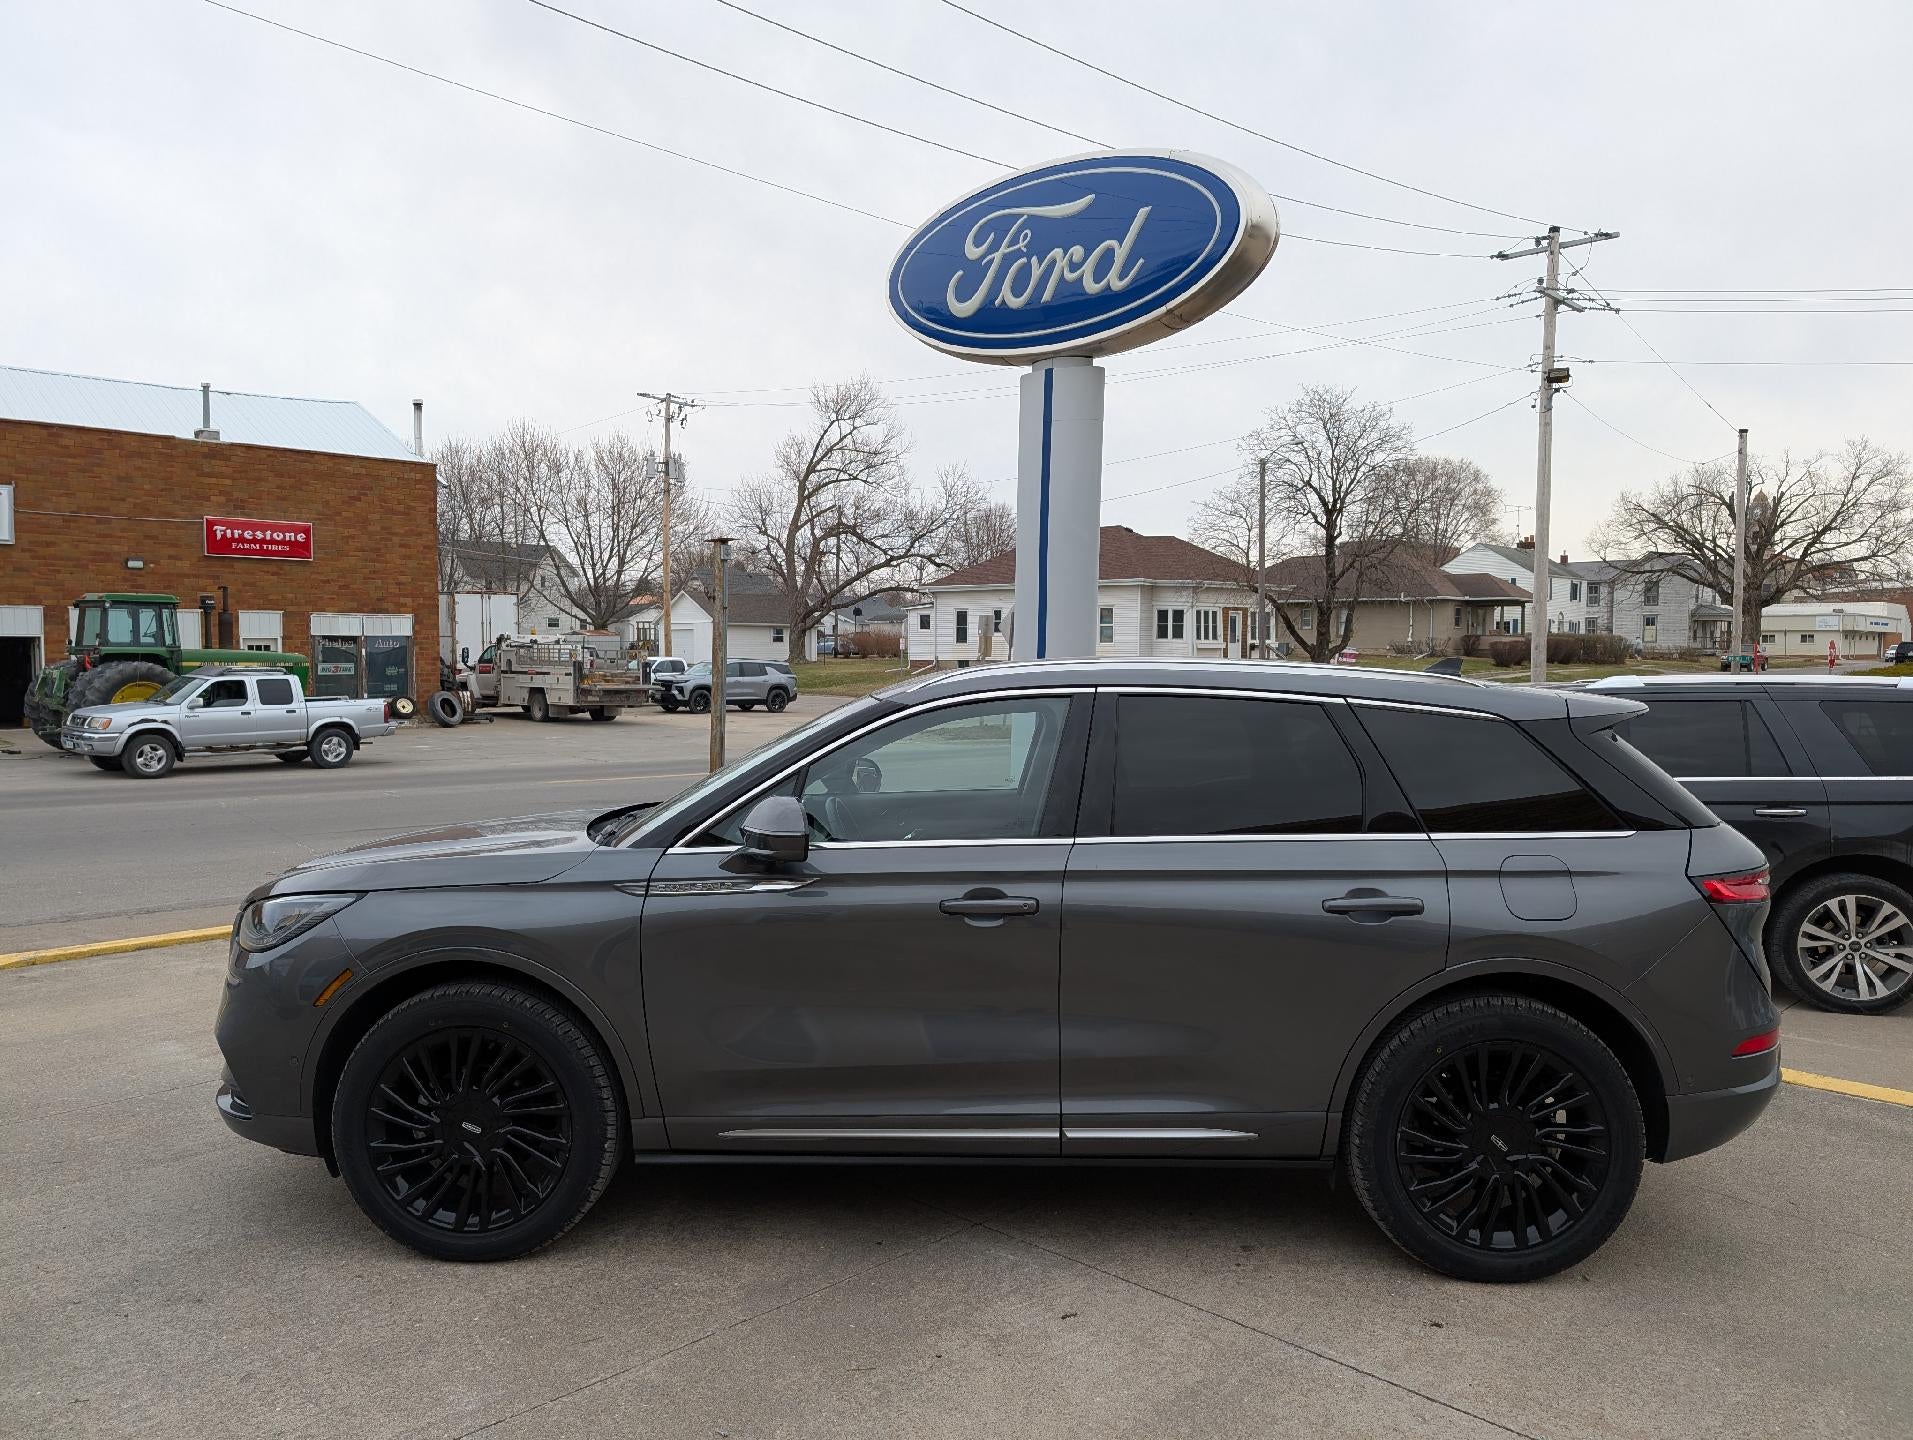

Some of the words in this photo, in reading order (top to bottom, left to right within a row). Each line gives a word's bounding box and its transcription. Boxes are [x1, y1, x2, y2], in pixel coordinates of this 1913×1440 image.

[946, 193, 1152, 319] Ford
[213, 525, 306, 542] Firestone
[231, 542, 260, 550] FARM
[375, 640, 400, 648] Auto
